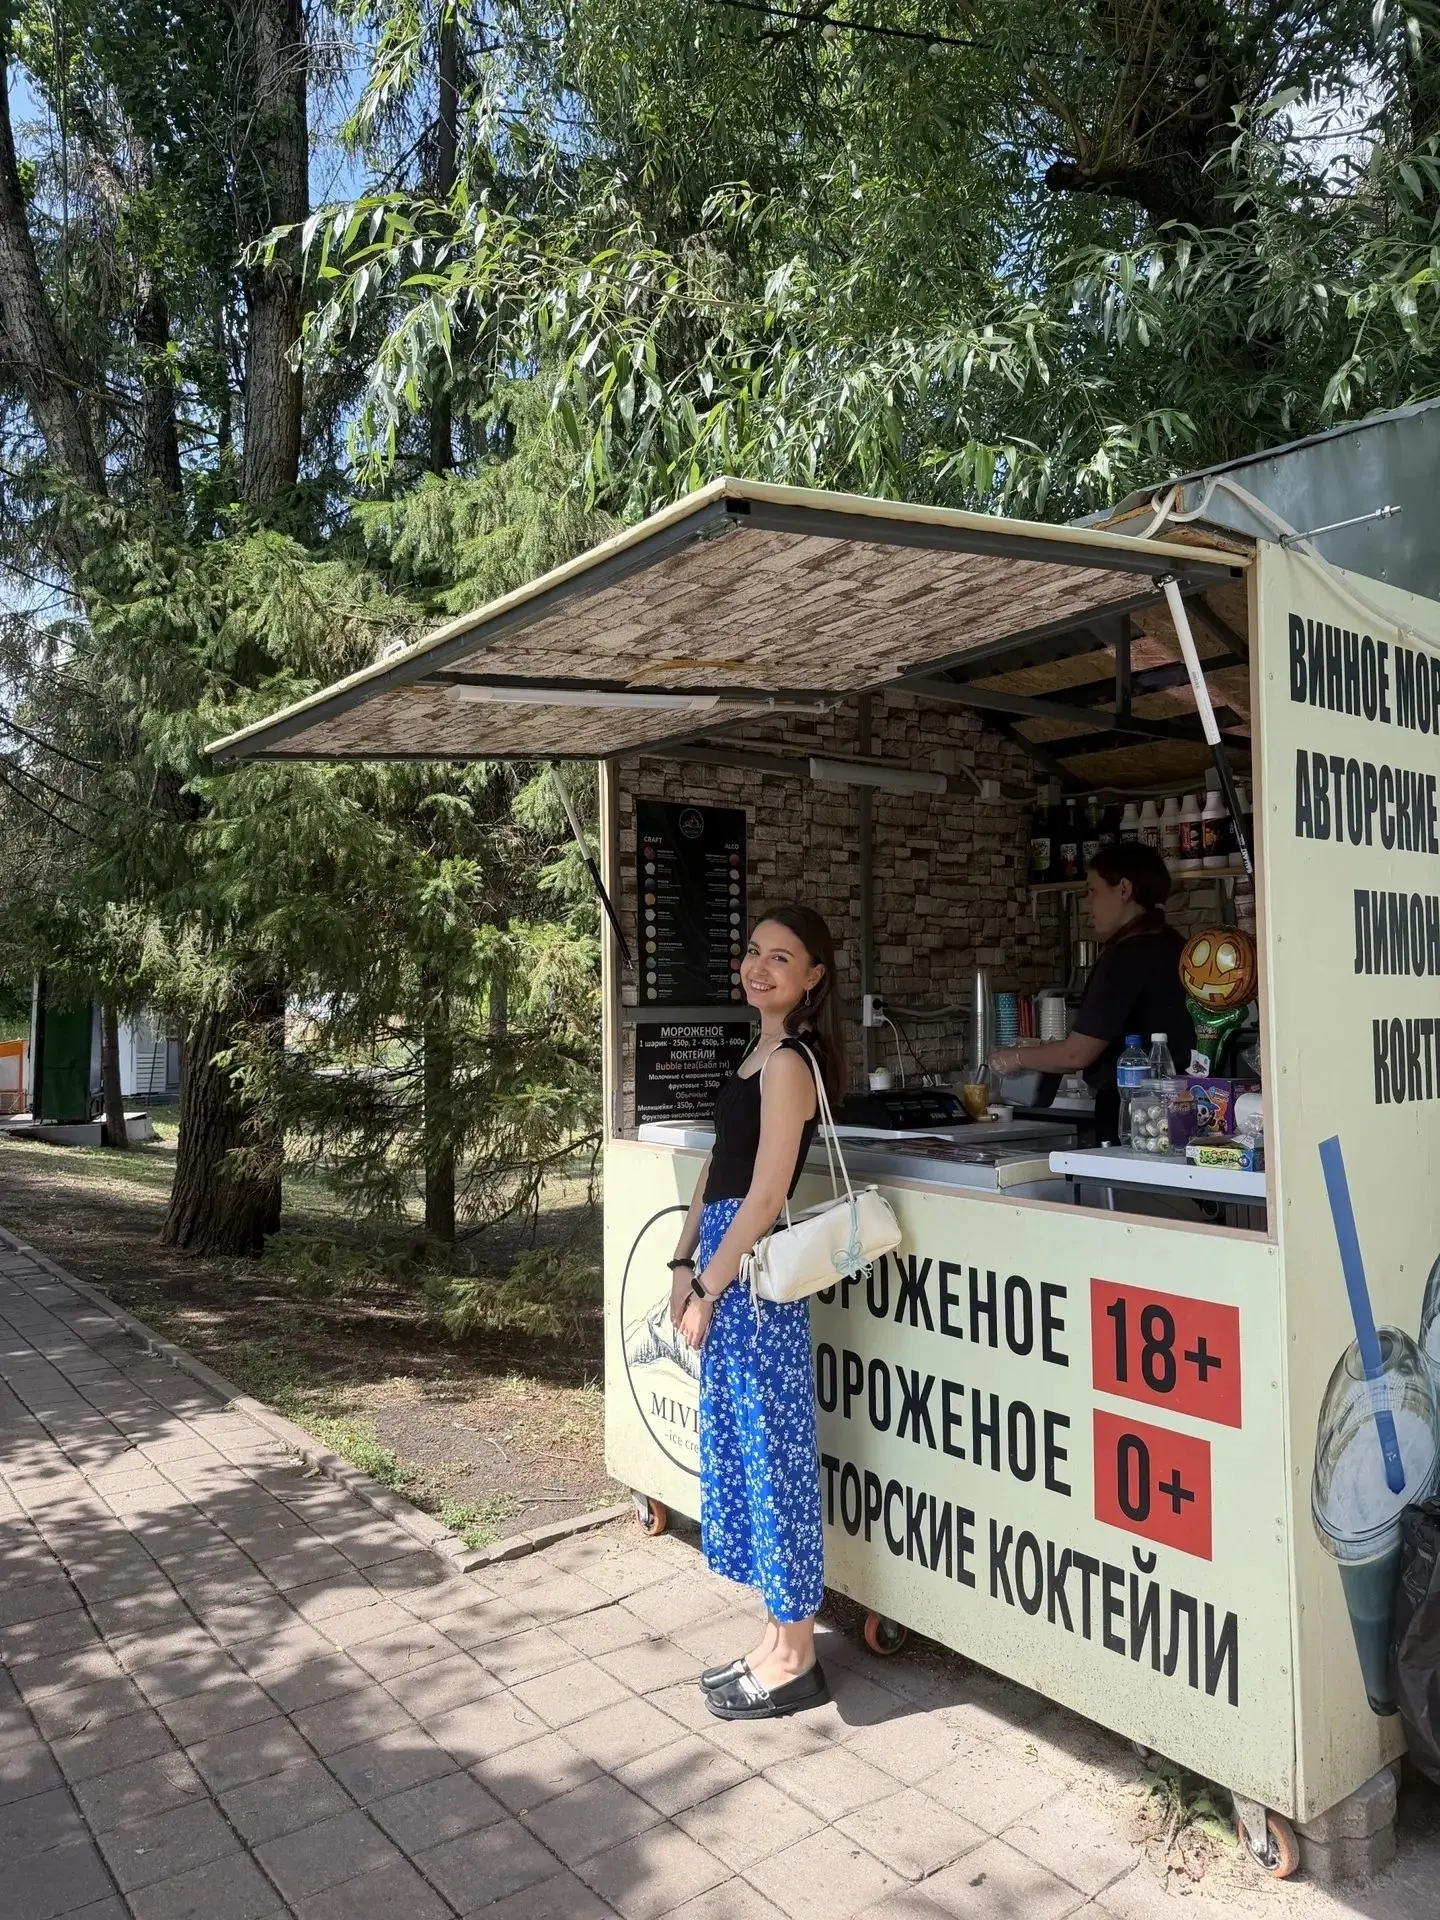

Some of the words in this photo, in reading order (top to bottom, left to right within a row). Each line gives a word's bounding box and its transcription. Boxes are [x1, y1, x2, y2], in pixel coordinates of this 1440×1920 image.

[1288, 612, 1391, 727] ВИННОЕ
[1394, 645, 1440, 736] МОР
[1295, 748, 1439, 855] АВТОРСКИЕ
[1353, 888, 1440, 976] ЛИМОН
[655, 1062, 682, 1071] Bubble
[660, 1026, 724, 1037] МОРОЖЕНОЕ
[670, 1048, 716, 1059] КОКТЕЙЛИ
[1372, 1017, 1440, 1105] КОКТ
[1106, 1297, 1222, 1393] 18+
[1116, 1433, 1195, 1522] 0+
[989, 1518, 1239, 1708] КОКТЕЙЛИ
